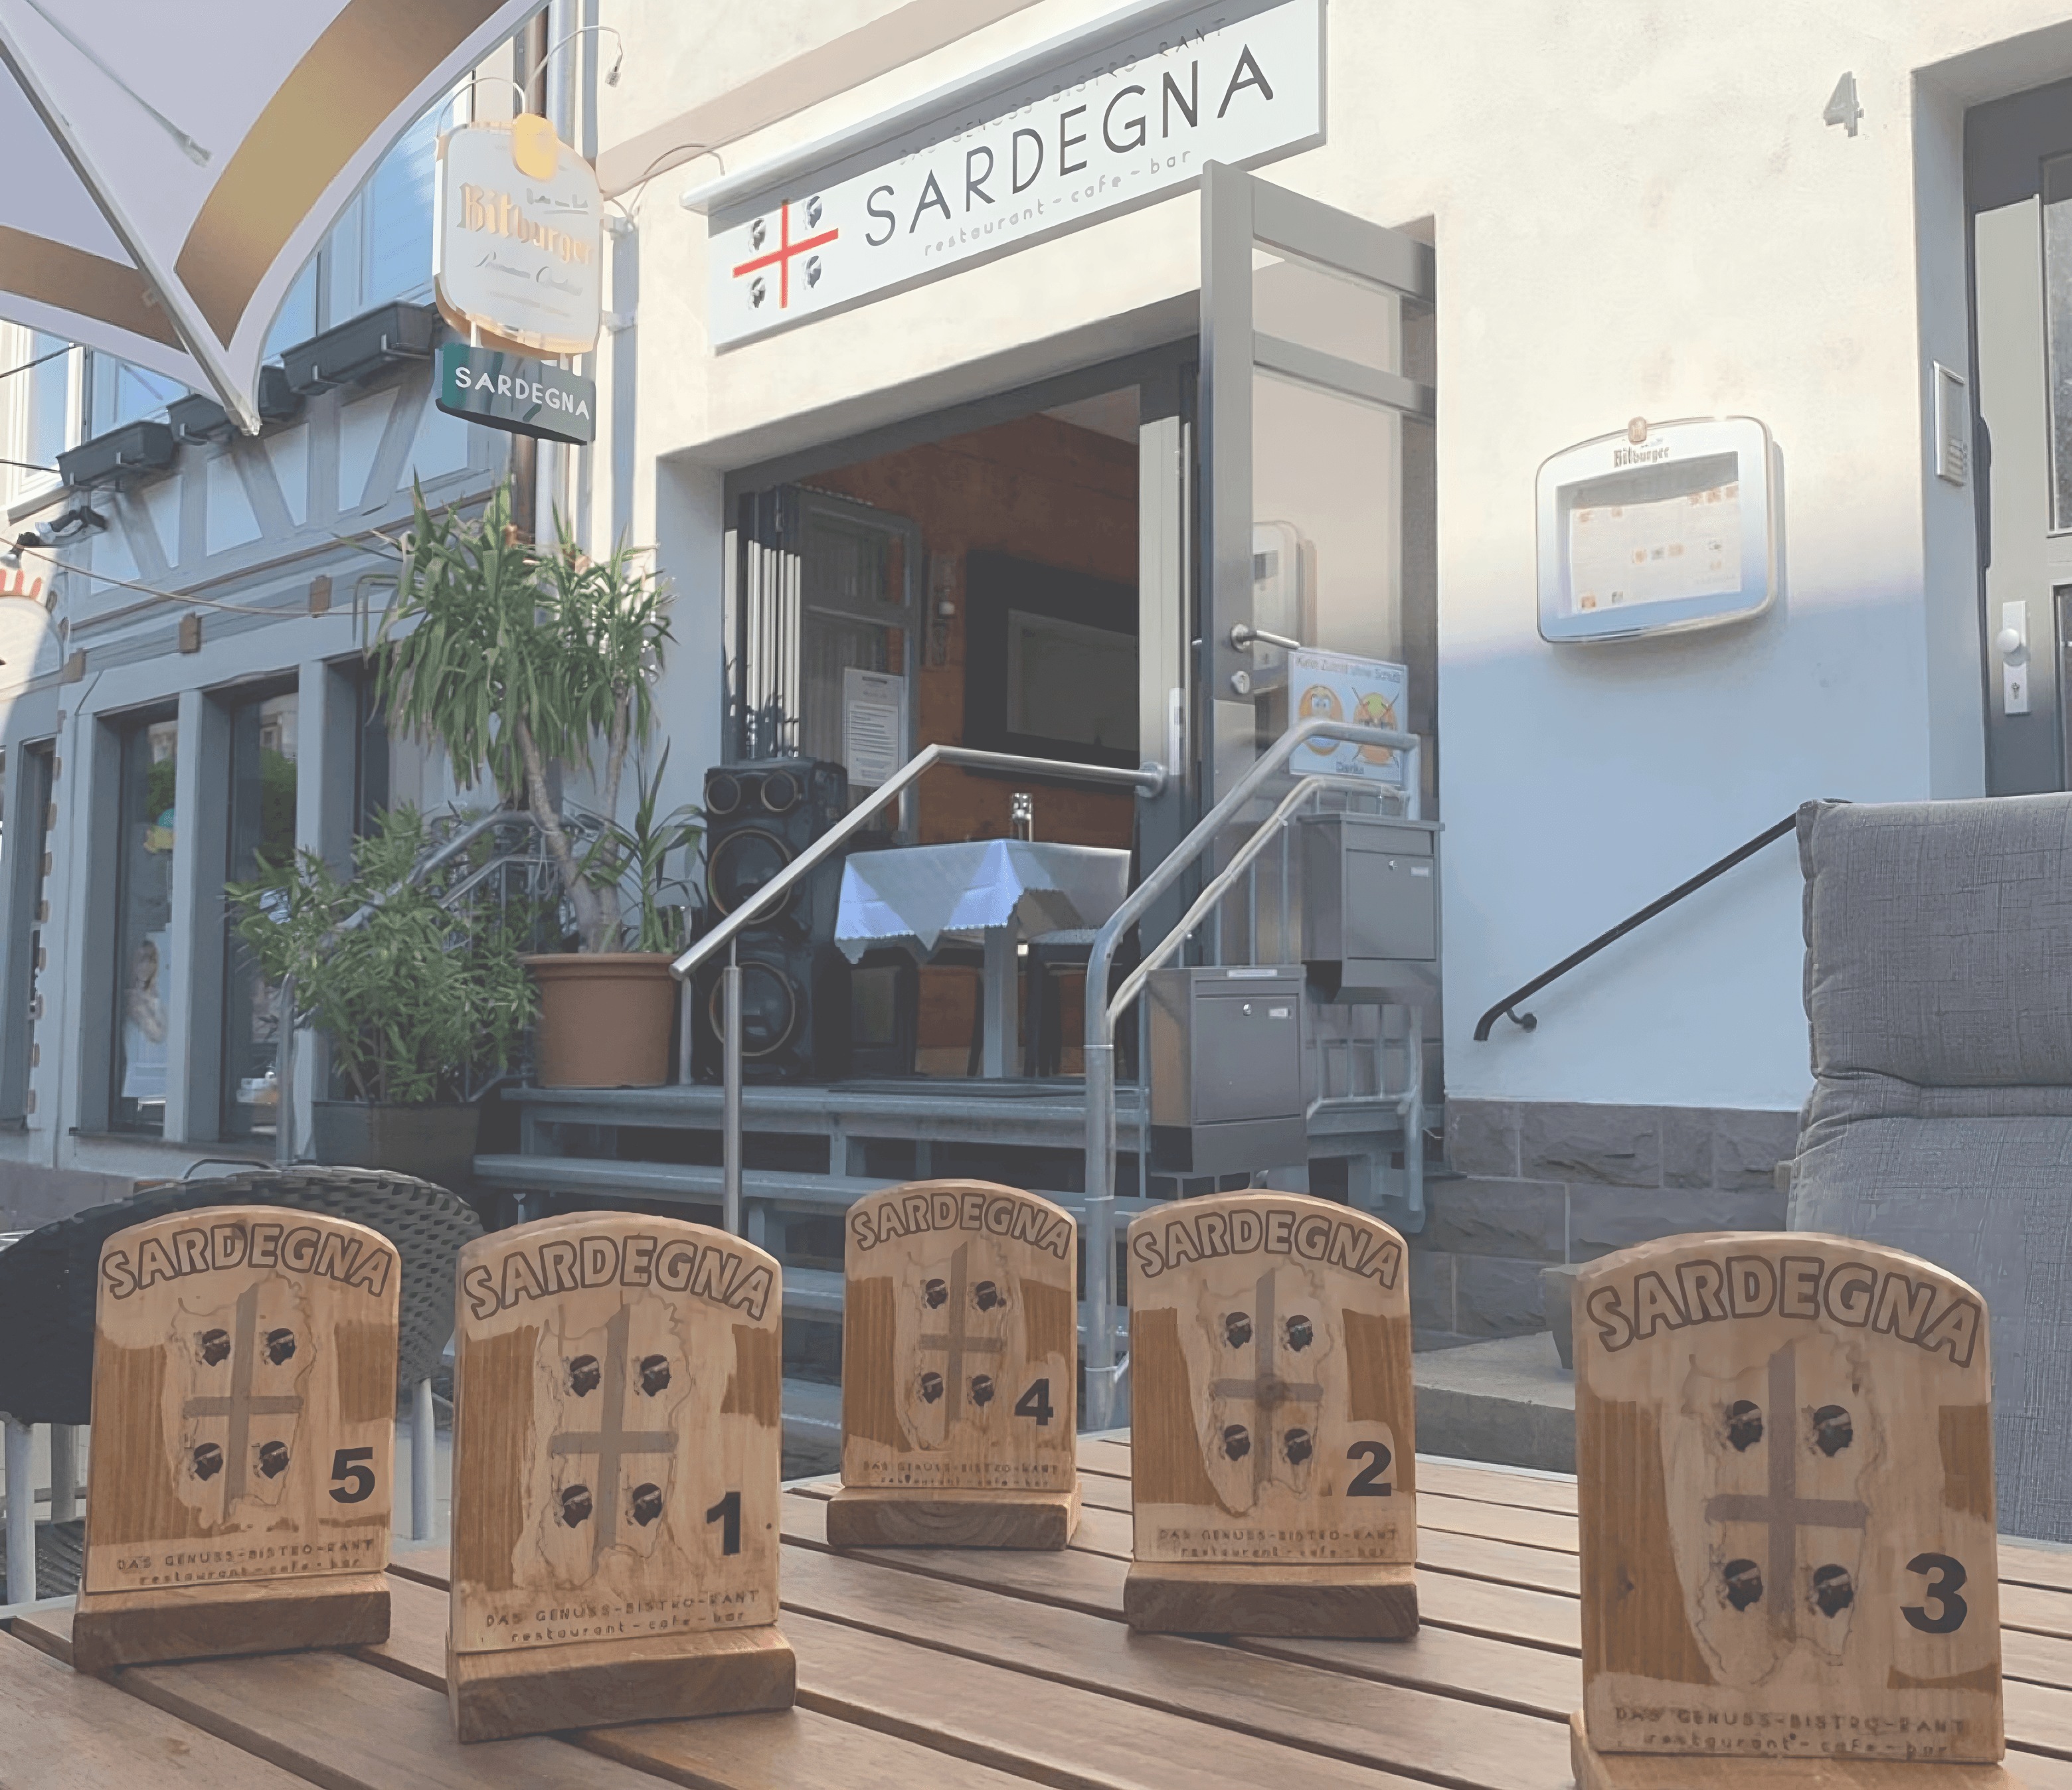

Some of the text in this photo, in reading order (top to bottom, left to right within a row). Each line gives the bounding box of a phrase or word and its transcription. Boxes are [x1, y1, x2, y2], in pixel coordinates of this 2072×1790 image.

[1823, 71, 1864, 137] 4
[865, 43, 1274, 247] SARDEGNA
[455, 366, 590, 420] SARDEGNA
[851, 1193, 1073, 1260] SARDEGNA
[1134, 1210, 1402, 1290] SARDEGNA
[102, 1223, 392, 1301] SARDEGNA
[464, 1236, 773, 1321] SARDEGNA
[1587, 1256, 1982, 1368] SARDEGNA
[1014, 1378, 1054, 1426] 4
[329, 1447, 376, 1504] 5
[1345, 1441, 1393, 1497] 2
[706, 1491, 741, 1556] 1
[1899, 1552, 1968, 1634] 3
